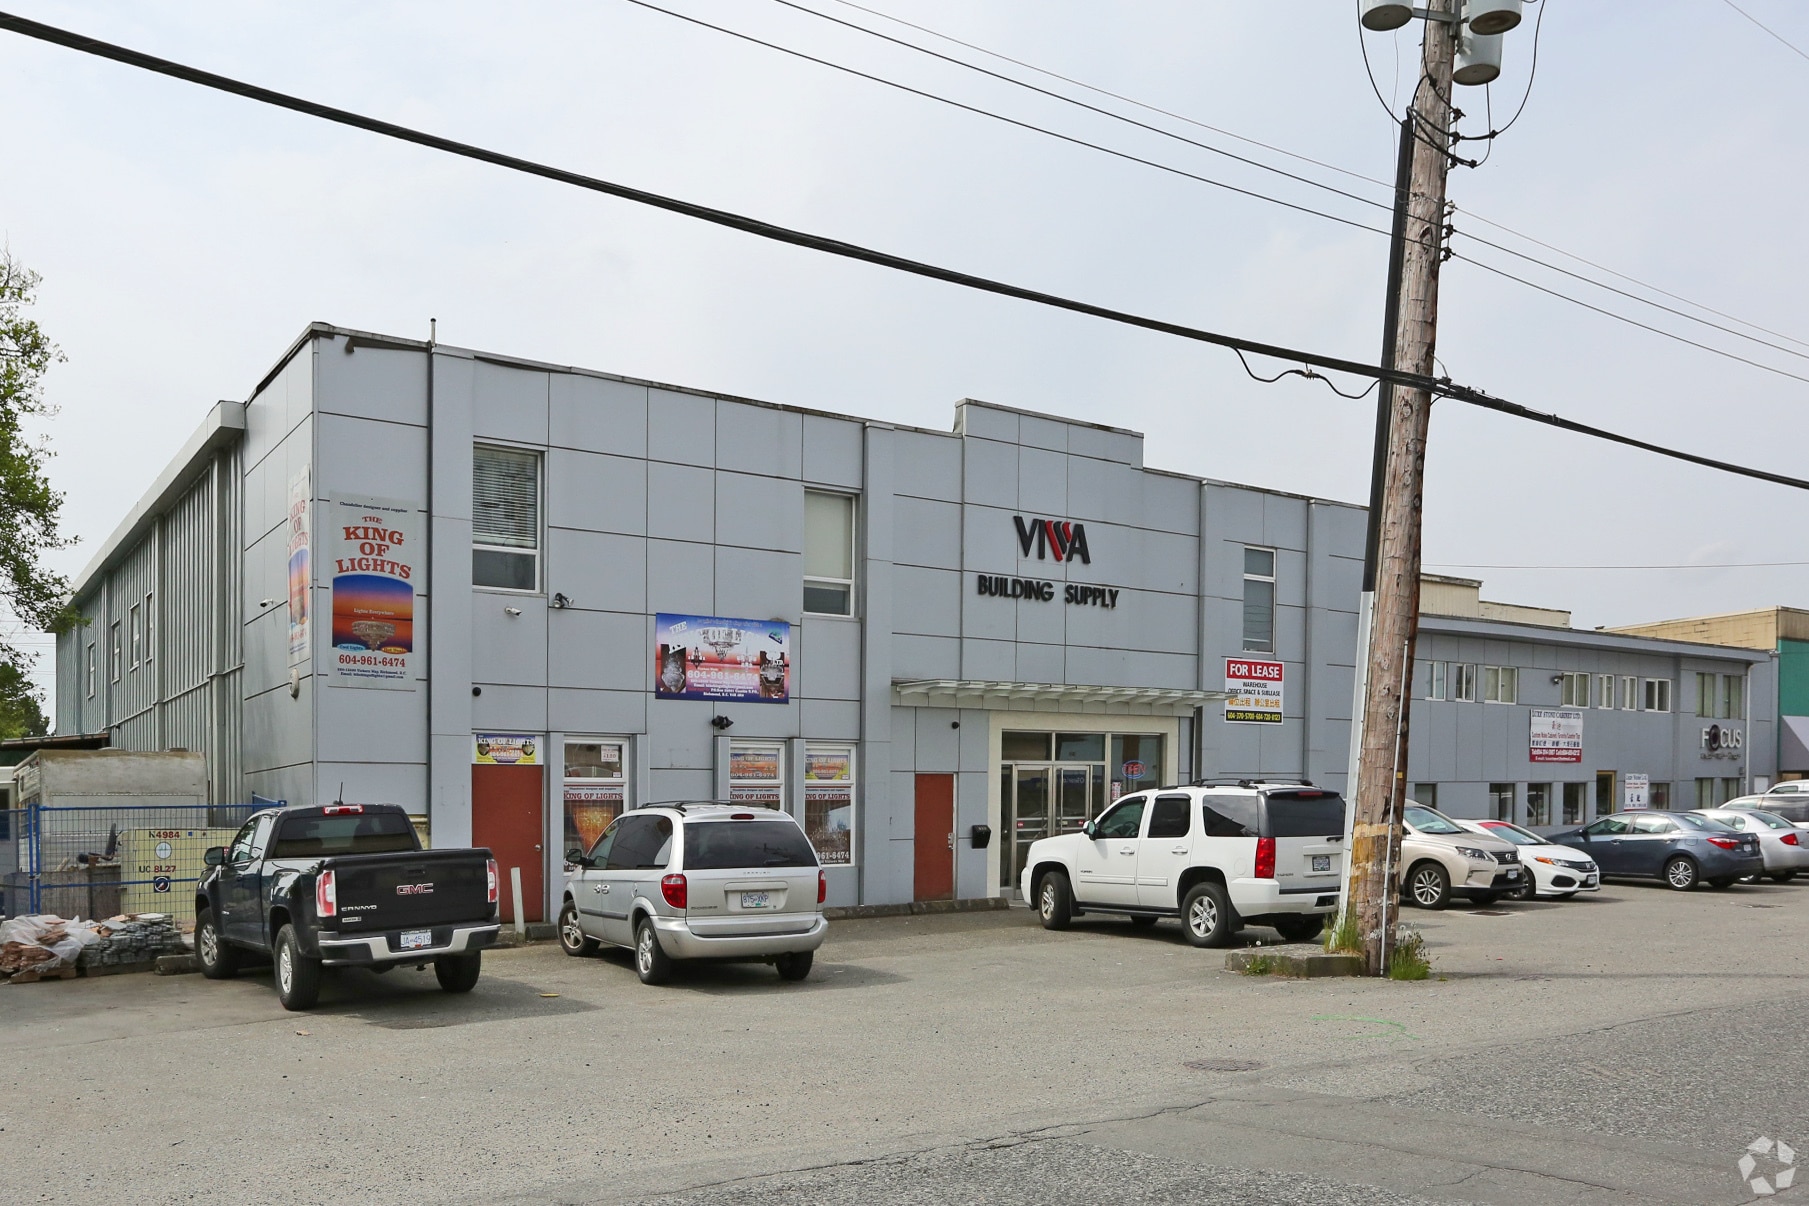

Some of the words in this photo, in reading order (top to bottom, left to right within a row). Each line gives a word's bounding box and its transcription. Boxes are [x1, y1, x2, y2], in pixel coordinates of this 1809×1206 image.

[362, 516, 383, 525] THE
[343, 526, 404, 546] KING
[360, 542, 390, 557] OF
[336, 558, 411, 579] LIGHTS
[978, 575, 1055, 602] BUILDING
[1065, 584, 1120, 610] SUPPLY
[670, 621, 688, 634] THE
[339, 654, 405, 667] 604-961-6474
[1230, 664, 1248, 676] FOR
[1252, 665, 1280, 678] LEASE
[1702, 724, 1741, 751] FOCUS
[397, 883, 433, 895] GMC
